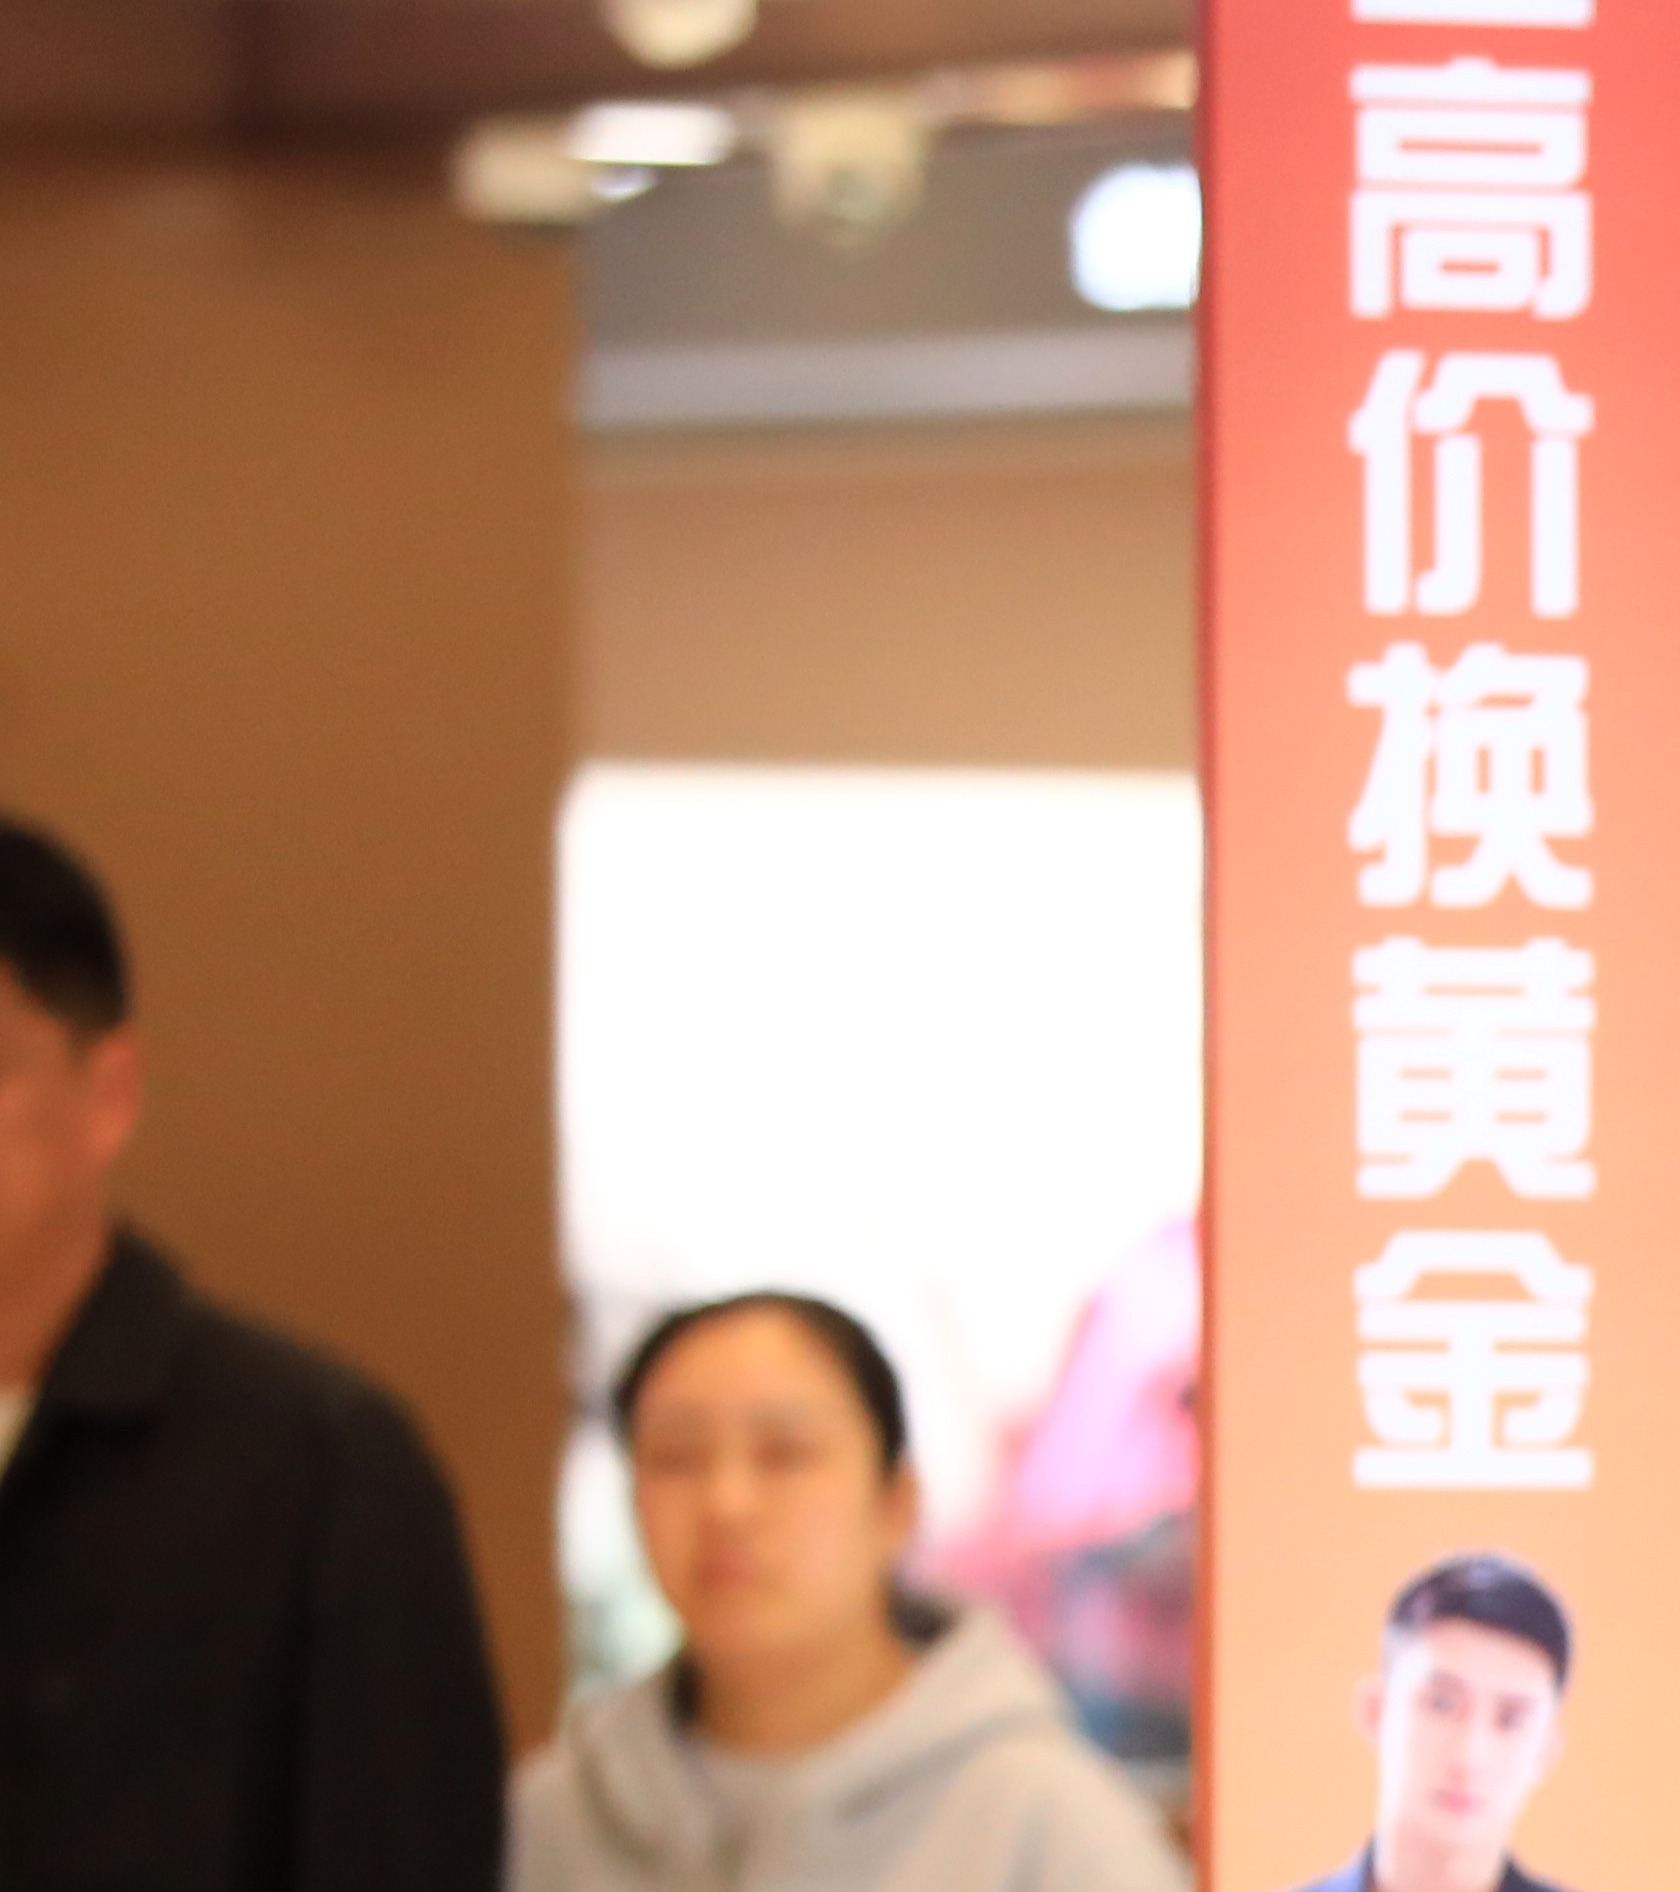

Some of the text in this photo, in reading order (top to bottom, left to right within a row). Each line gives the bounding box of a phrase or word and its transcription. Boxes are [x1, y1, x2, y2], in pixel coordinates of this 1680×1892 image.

[1347, 0, 1595, 1490] 高价换黄金
